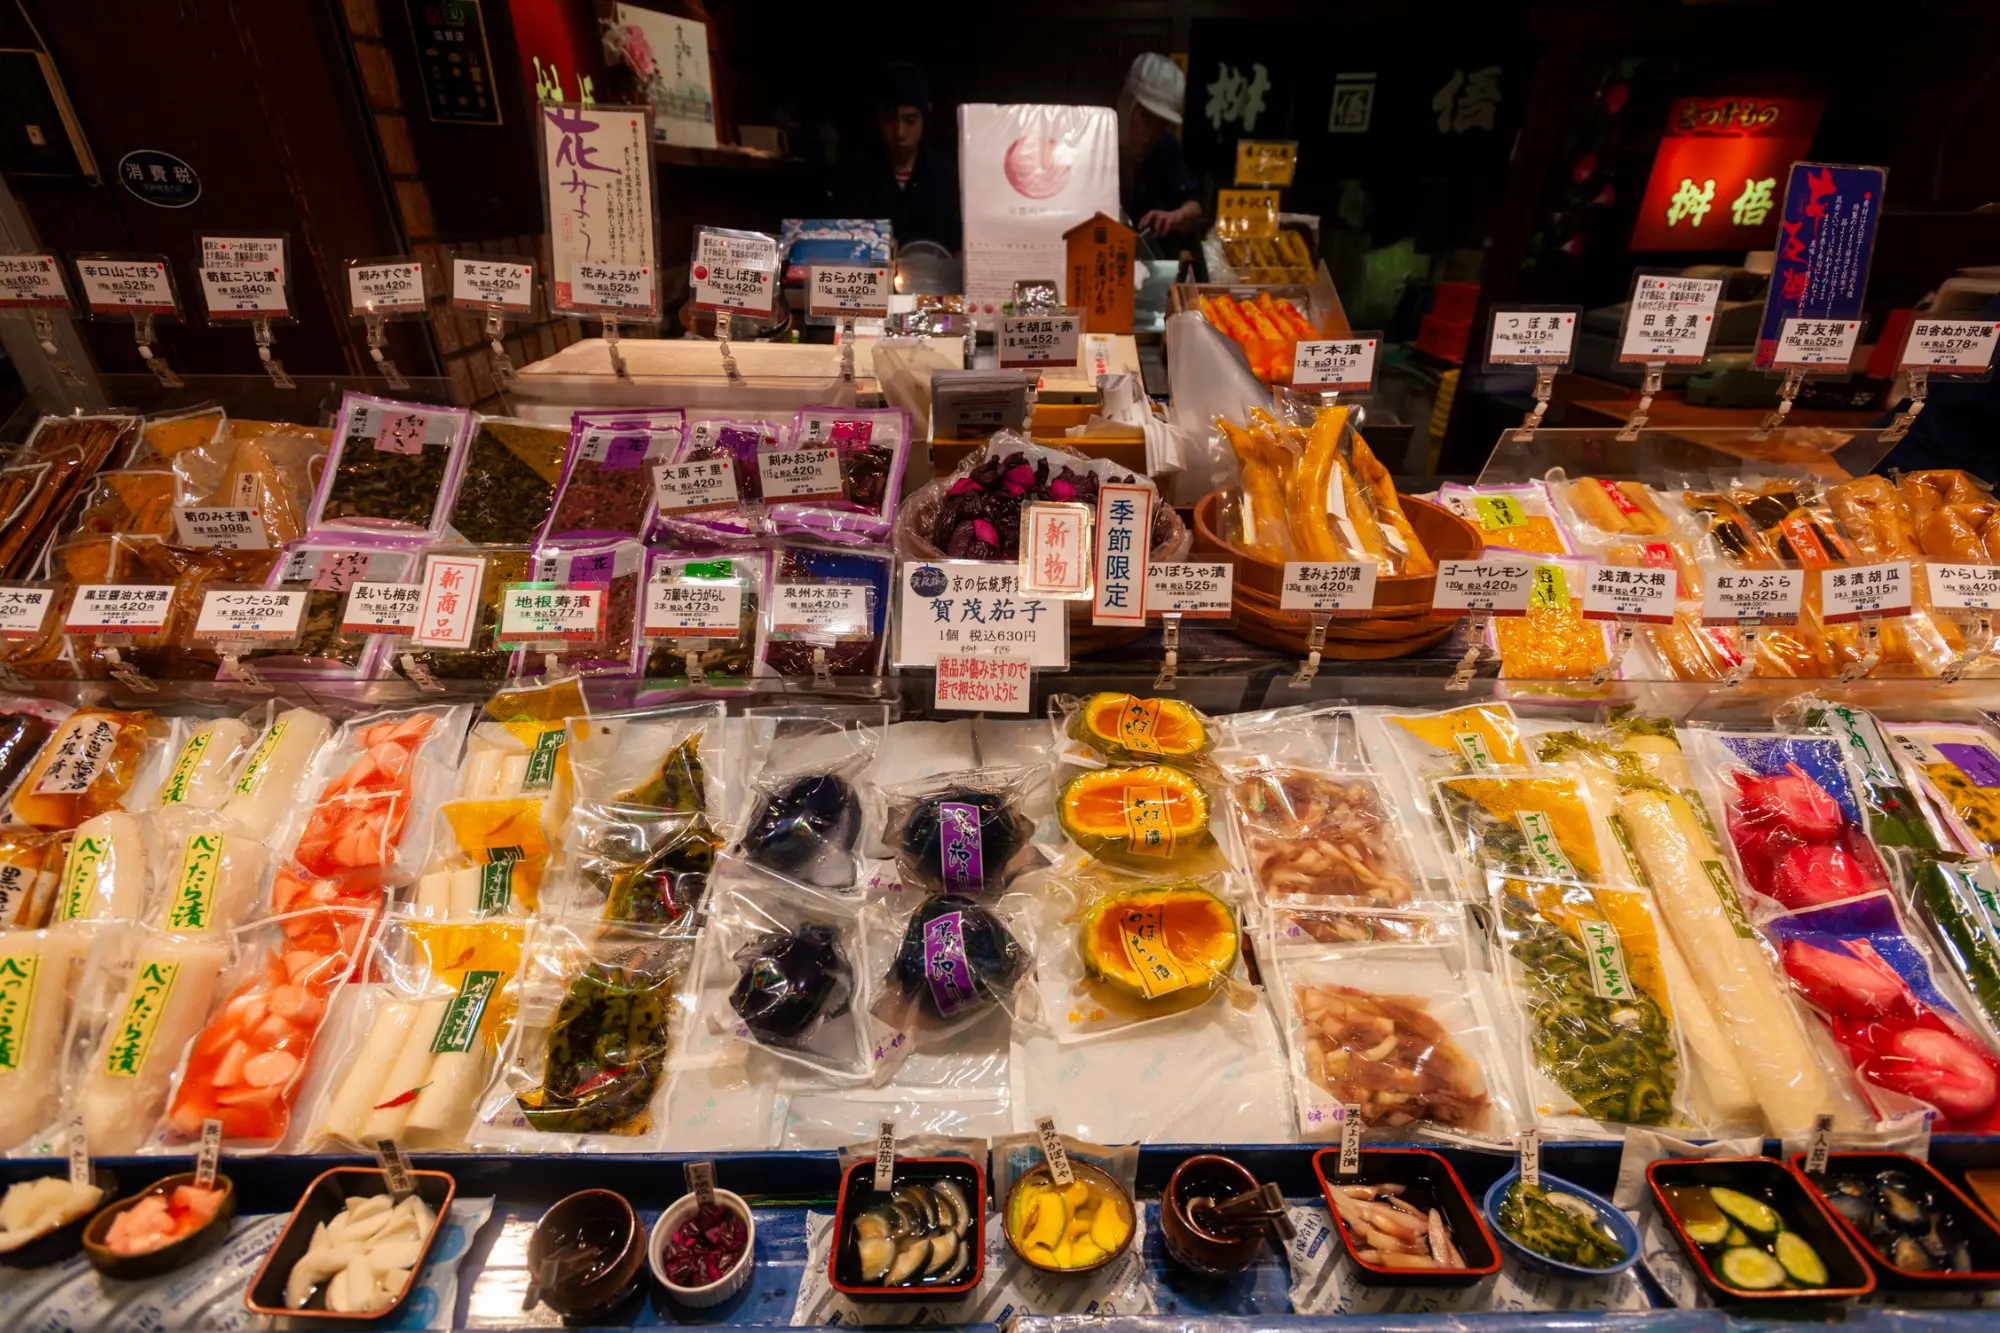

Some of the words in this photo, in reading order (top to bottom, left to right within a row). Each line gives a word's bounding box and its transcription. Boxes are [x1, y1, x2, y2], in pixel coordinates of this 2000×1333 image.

[126, 162, 192, 186] 消費税
[84, 265, 160, 279] 辛口山ごぼう
[206, 271, 277, 284] 筍紅こうじ漬
[357, 268, 412, 282] 刻みすぐき
[463, 265, 523, 279] 京ごぜん
[580, 266, 642, 281] 花みょうが
[712, 267, 763, 284] 生しば漬
[818, 269, 878, 285] おらが漬
[1004, 320, 1074, 334] しそ胡瓜・赤
[1508, 316, 1561, 330] つぼ漬
[1643, 313, 1700, 329] 田舎漬
[1512, 330, 1554, 341] 税込315円
[1652, 328, 1697, 338] 税込472円
[1794, 322, 1845, 337] 京友禅
[1915, 325, 1994, 338] 田舎ぬか沢庵
[1803, 337, 1844, 347] 税込525円
[1932, 339, 1978, 349] 税込578円
[1304, 343, 1364, 357] 千本漬
[1314, 357, 1356, 368] 税込315円
[767, 450, 830, 467] 刻みおらが
[662, 464, 723, 481] 大原千里
[779, 465, 823, 477] 税込420円
[680, 476, 723, 490] 税込420円
[184, 511, 250, 523] 筍のみそ漬
[1043, 517, 1070, 585] 新物
[1104, 499, 1135, 609] 季節限定
[1147, 564, 1227, 579] かぼちゃ漬
[1298, 565, 1361, 581] 茎みょうが漬
[1443, 563, 1529, 578] ゴーヤレモン
[1598, 568, 1667, 586] 浅漬大根
[1716, 575, 1792, 590] 紅かぶら
[1832, 568, 1901, 588] 浅漬胡瓜
[1170, 580, 1219, 591] 税込525円
[1304, 581, 1354, 593] 税込420円
[1467, 579, 1517, 592] 税込420円
[1614, 585, 1662, 599] 税込473円
[1851, 584, 1899, 597] 税込315円
[84, 589, 168, 602] 黒豆醤油大根漬
[355, 587, 420, 601] 長いも梅肉
[662, 587, 726, 602] 万願寺とうがらし
[783, 587, 853, 599] 泉州水茄子
[1736, 590, 1788, 602] 税込525円
[104, 601, 154, 612] 税込420円
[216, 594, 290, 607] べったら漬
[374, 602, 420, 612] 税込473
[431, 566, 464, 638] 新商品
[515, 594, 592, 609] 地根寿漬
[669, 601, 719, 612] 税込473円
[800, 600, 849, 609] 税込420円
[231, 606, 283, 617] 税込420円
[533, 606, 584, 618] 税込577円
[929, 598, 1048, 624] 賀茂茄子
[938, 629, 959, 642] 1個
[969, 628, 1037, 643] 税込630円
[938, 656, 1028, 680] 商品が傷みますので
[937, 680, 1019, 702] 指で押さないように
[169, 835, 221, 929] べったら漬
[1587, 923, 1625, 996] ゴーヤレモン
[108, 962, 174, 1076] べったら漬
[1342, 1108, 1360, 1168] 茎みょうが漬
[877, 1121, 894, 1178] 賀茂茄子
[1040, 1119, 1070, 1179] 刻みかぼちゃ
